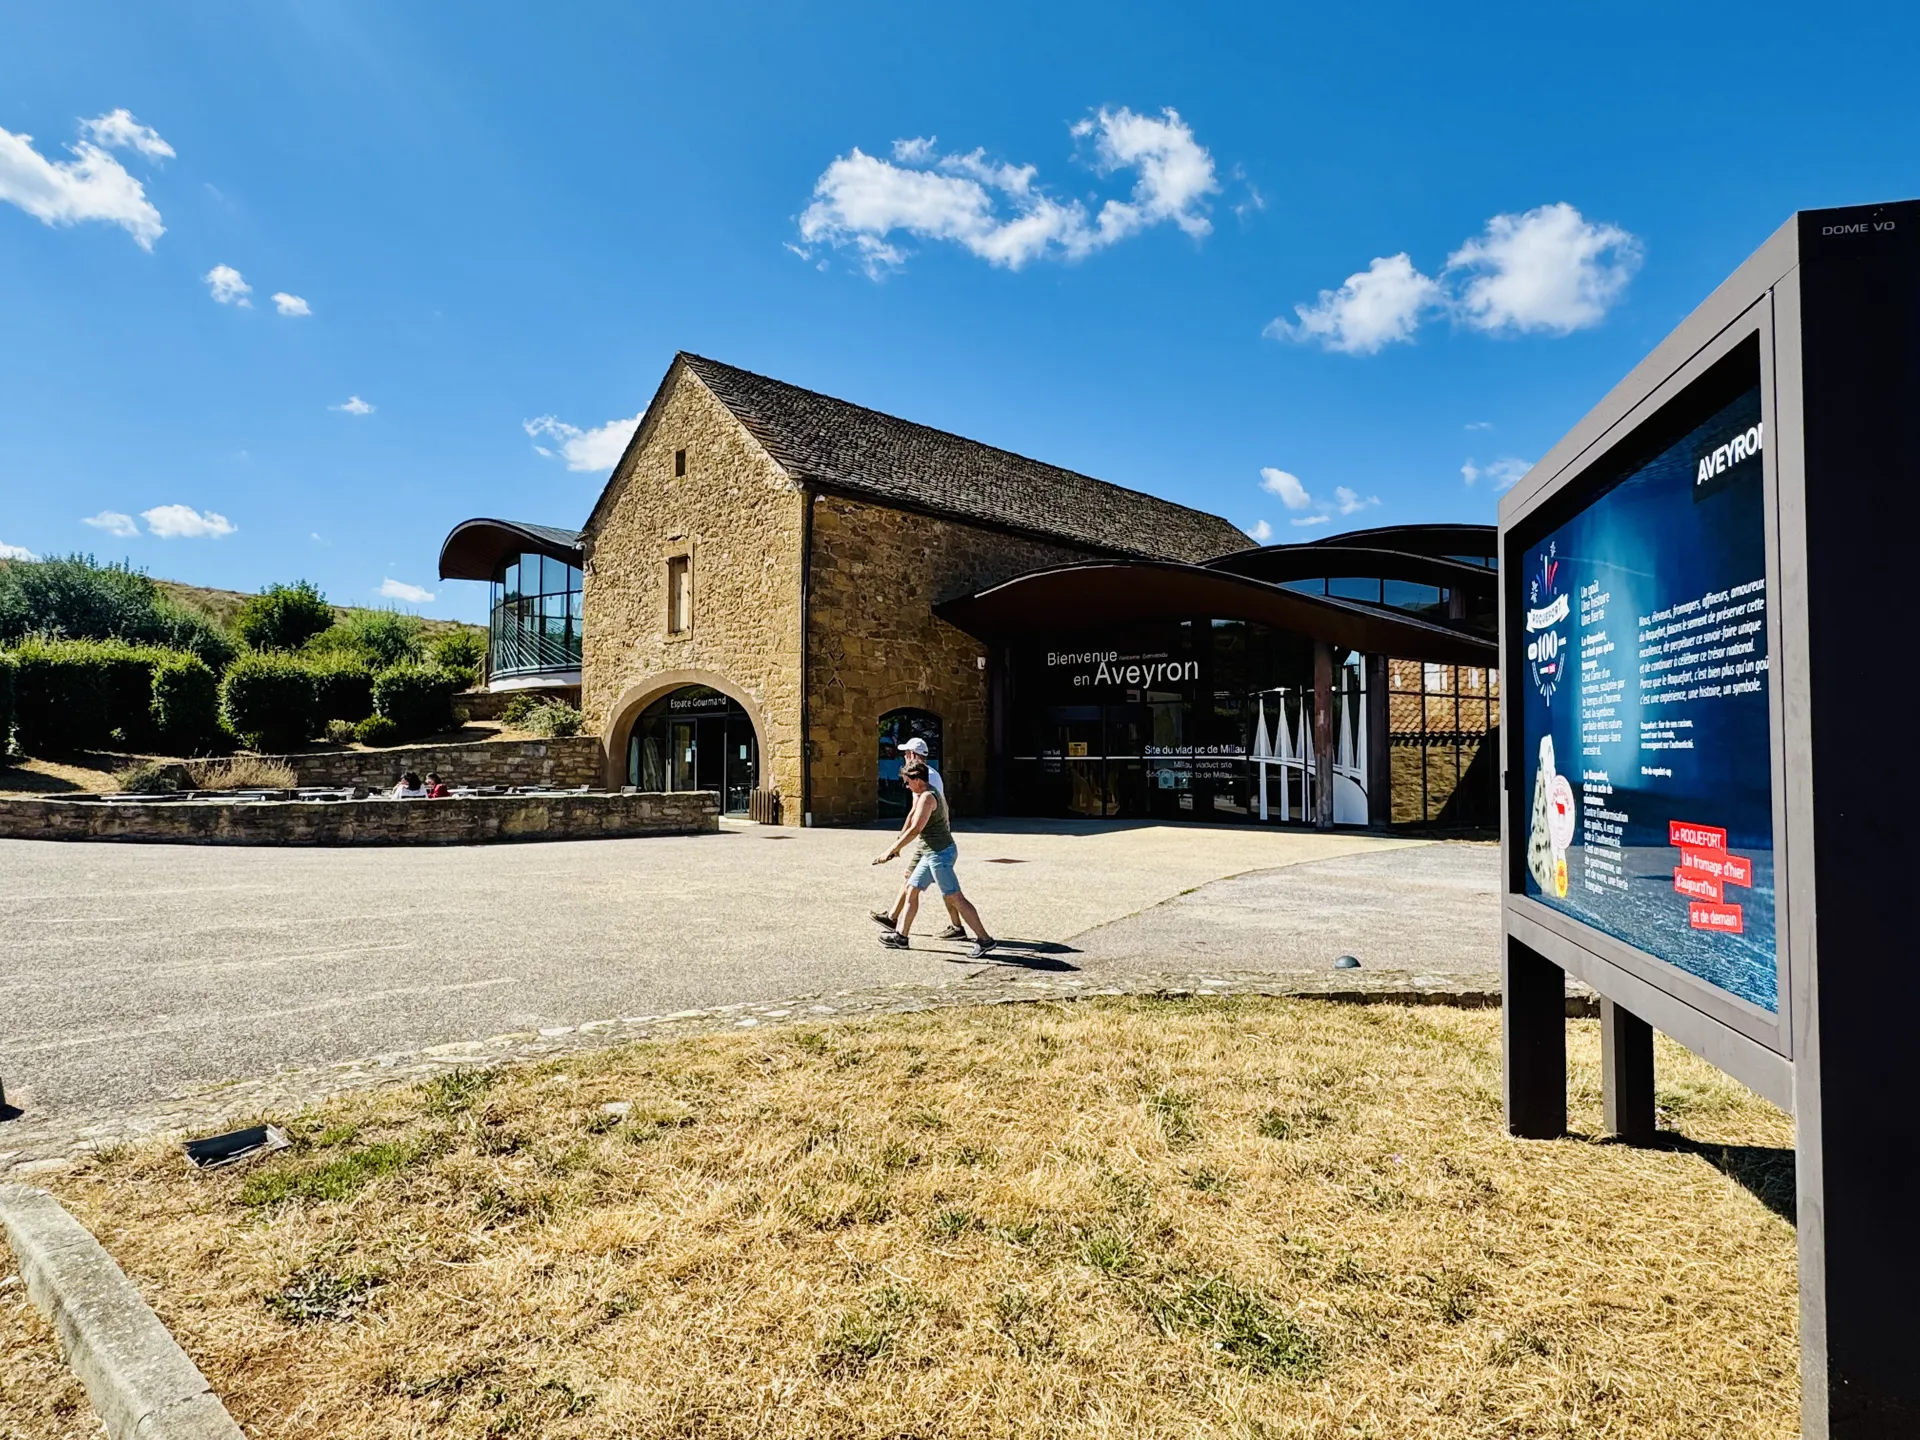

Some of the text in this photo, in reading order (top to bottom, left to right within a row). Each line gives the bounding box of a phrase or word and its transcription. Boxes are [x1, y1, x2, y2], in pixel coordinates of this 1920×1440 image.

[1822, 223, 1869, 236] DOME
[1673, 600, 1701, 619] fromagers,
[1702, 590, 1730, 609] affineurs,
[1730, 578, 1765, 598] amoureux
[1708, 610, 1716, 624] de
[1716, 606, 1746, 624] préserver
[1747, 598, 1765, 613] cette
[1696, 634, 1703, 645] ce
[1703, 625, 1737, 643] savoir-faire
[1738, 620, 1762, 635] unique
[1047, 651, 1118, 666] Bienvenue
[1537, 630, 1558, 663] 100
[1700, 652, 1707, 662] ce
[1708, 646, 1726, 660] trésor
[1726, 638, 1755, 657] national.
[1073, 661, 1199, 689] en Aveyron
[1708, 666, 1720, 678] bien
[1721, 662, 1735, 679] plus
[1735, 659, 1754, 677] qu'un
[1755, 655, 1769, 674] goû
[1688, 689, 1699, 699] une
[1723, 684, 1731, 695] un
[1732, 677, 1762, 696] symbole.
[670, 696, 727, 709] Espace Gourmand
[1144, 745, 1161, 754] Site
[1162, 745, 1173, 754] du
[1207, 744, 1218, 754] de
[1220, 744, 1246, 754] Millau
[1203, 770, 1211, 778] de
[1671, 825, 1723, 851] Le ROQUEFORT,
[1683, 852, 1745, 880] Un fromage d'hier
[1676, 874, 1717, 898] d'aujourd'hui
[1691, 909, 1737, 927] et de demain
